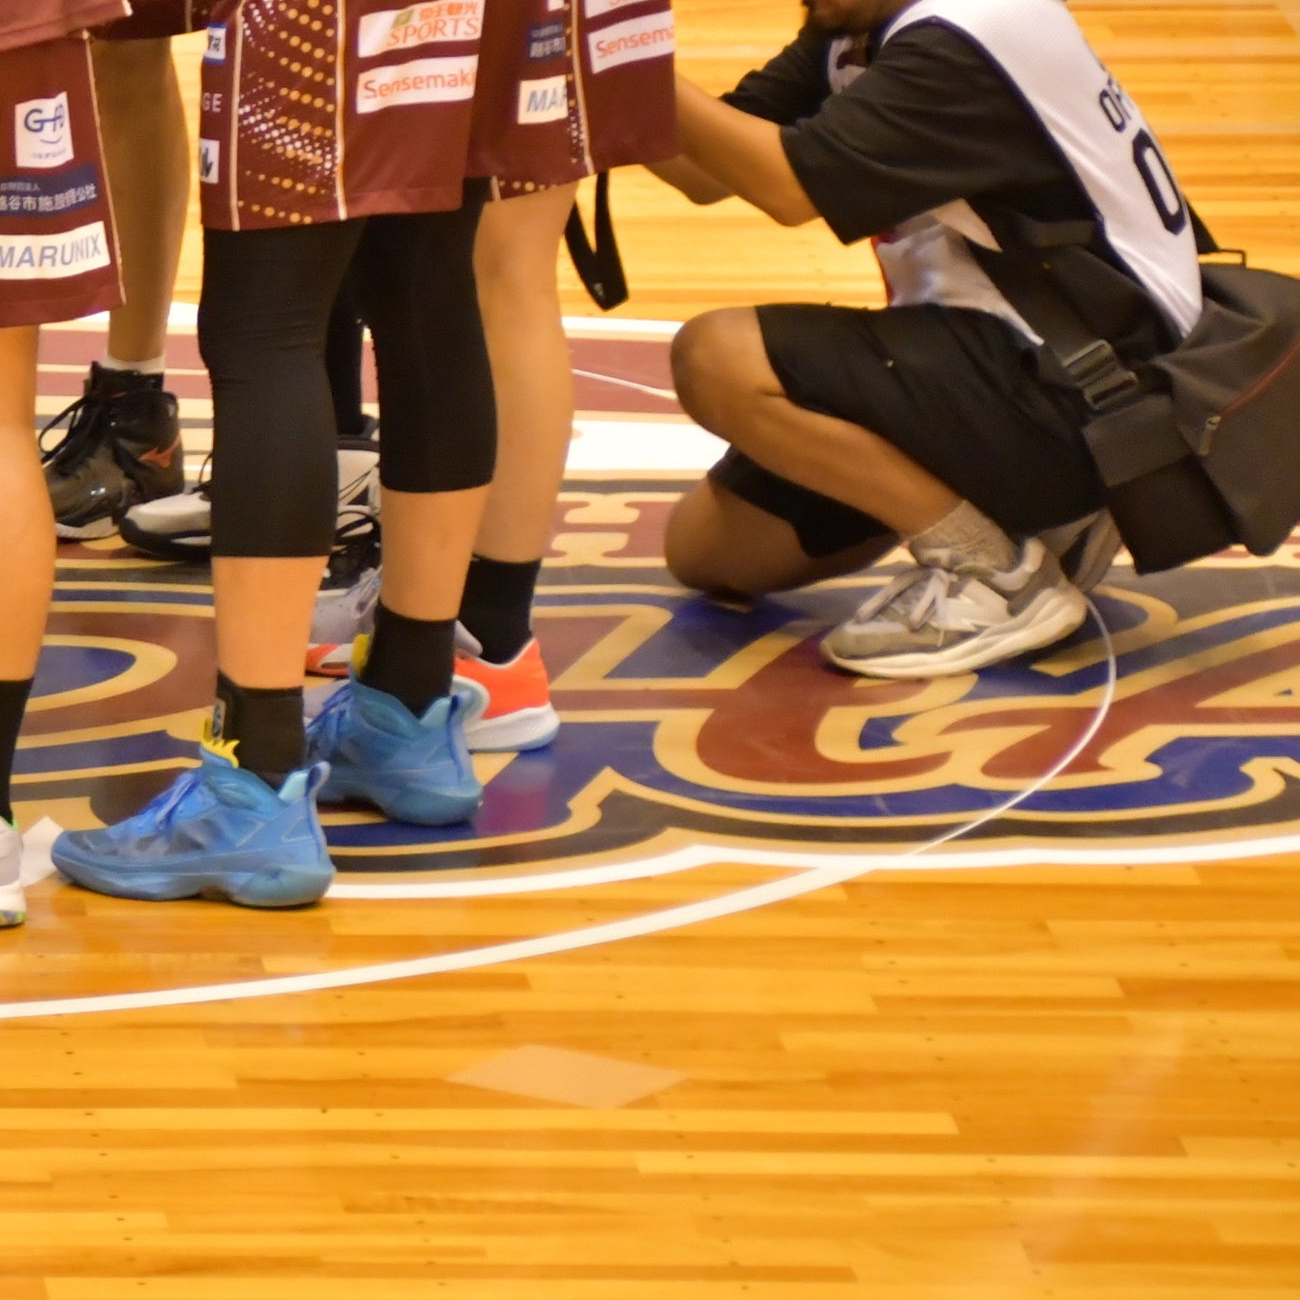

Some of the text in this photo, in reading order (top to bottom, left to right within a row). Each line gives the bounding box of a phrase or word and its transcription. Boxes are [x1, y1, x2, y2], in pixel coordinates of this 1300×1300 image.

[386, 16, 481, 48] SPORTS
[595, 26, 675, 60] Sensem
[363, 67, 474, 100] Sensemak
